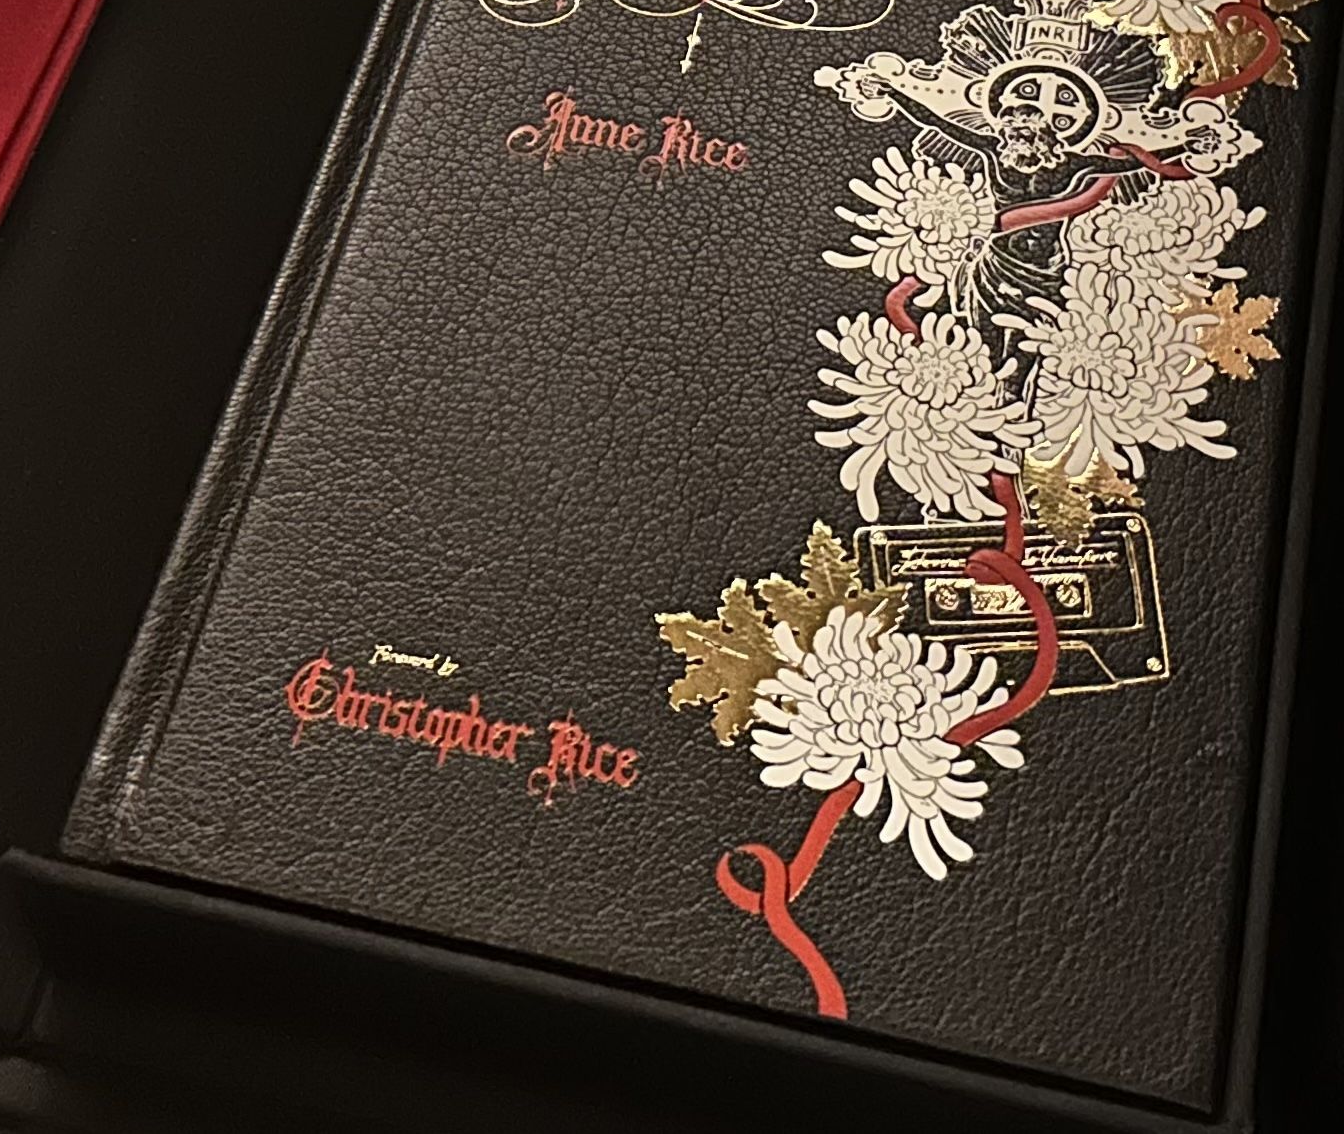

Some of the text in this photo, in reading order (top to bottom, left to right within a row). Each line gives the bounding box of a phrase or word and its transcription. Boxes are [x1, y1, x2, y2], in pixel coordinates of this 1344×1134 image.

[1029, 24, 1074, 44] INRI
[506, 87, 749, 178] Anne Rice
[283, 647, 640, 808] Christopher Rice
